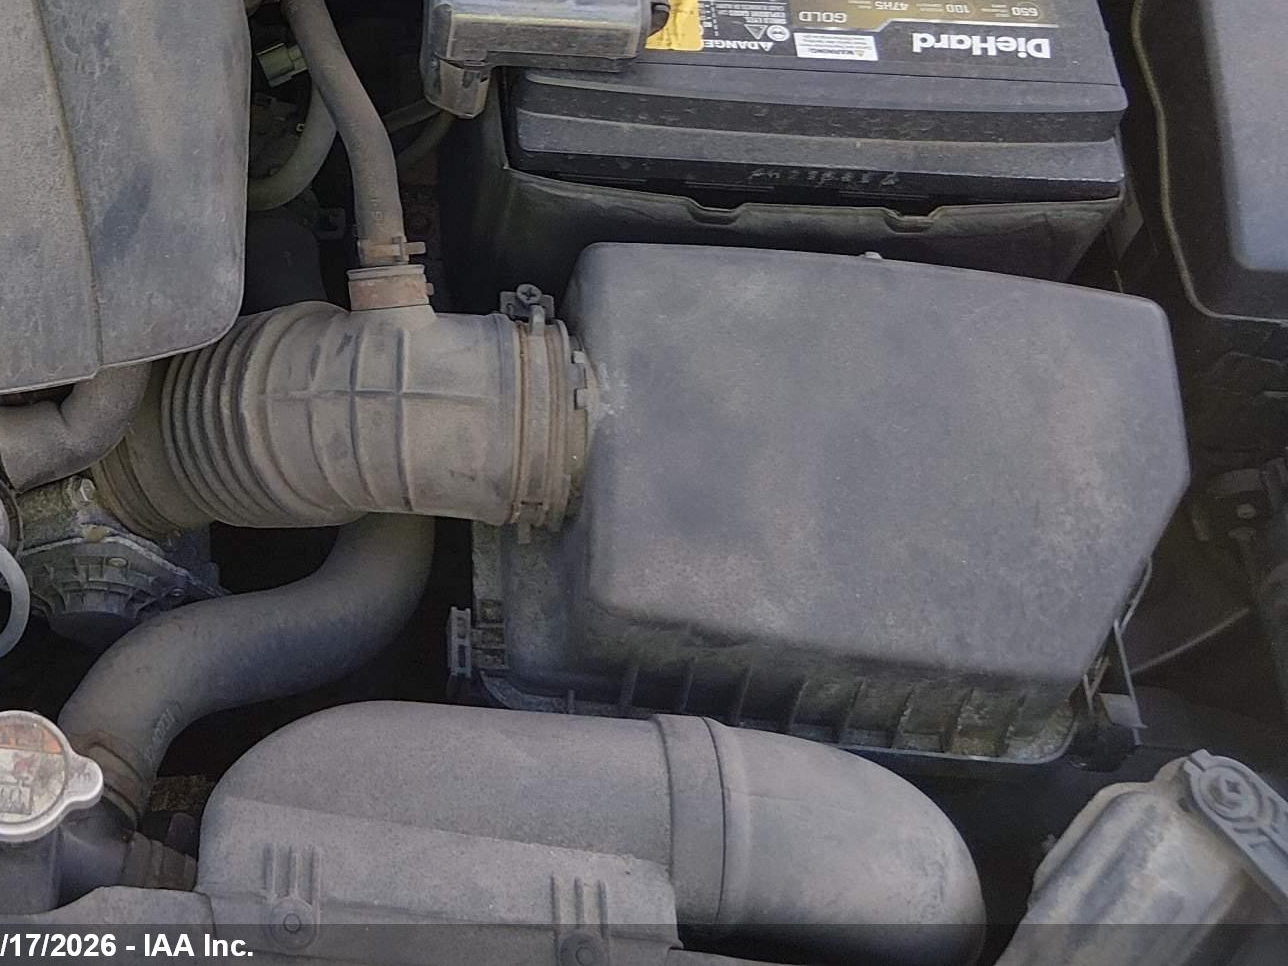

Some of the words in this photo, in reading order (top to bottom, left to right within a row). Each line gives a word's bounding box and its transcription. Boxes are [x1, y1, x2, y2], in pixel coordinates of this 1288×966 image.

[946, 4, 971, 14] 100
[799, 11, 848, 24] GOLD
[703, 39, 760, 50] DANGE
[912, 33, 1051, 59] DieHard
